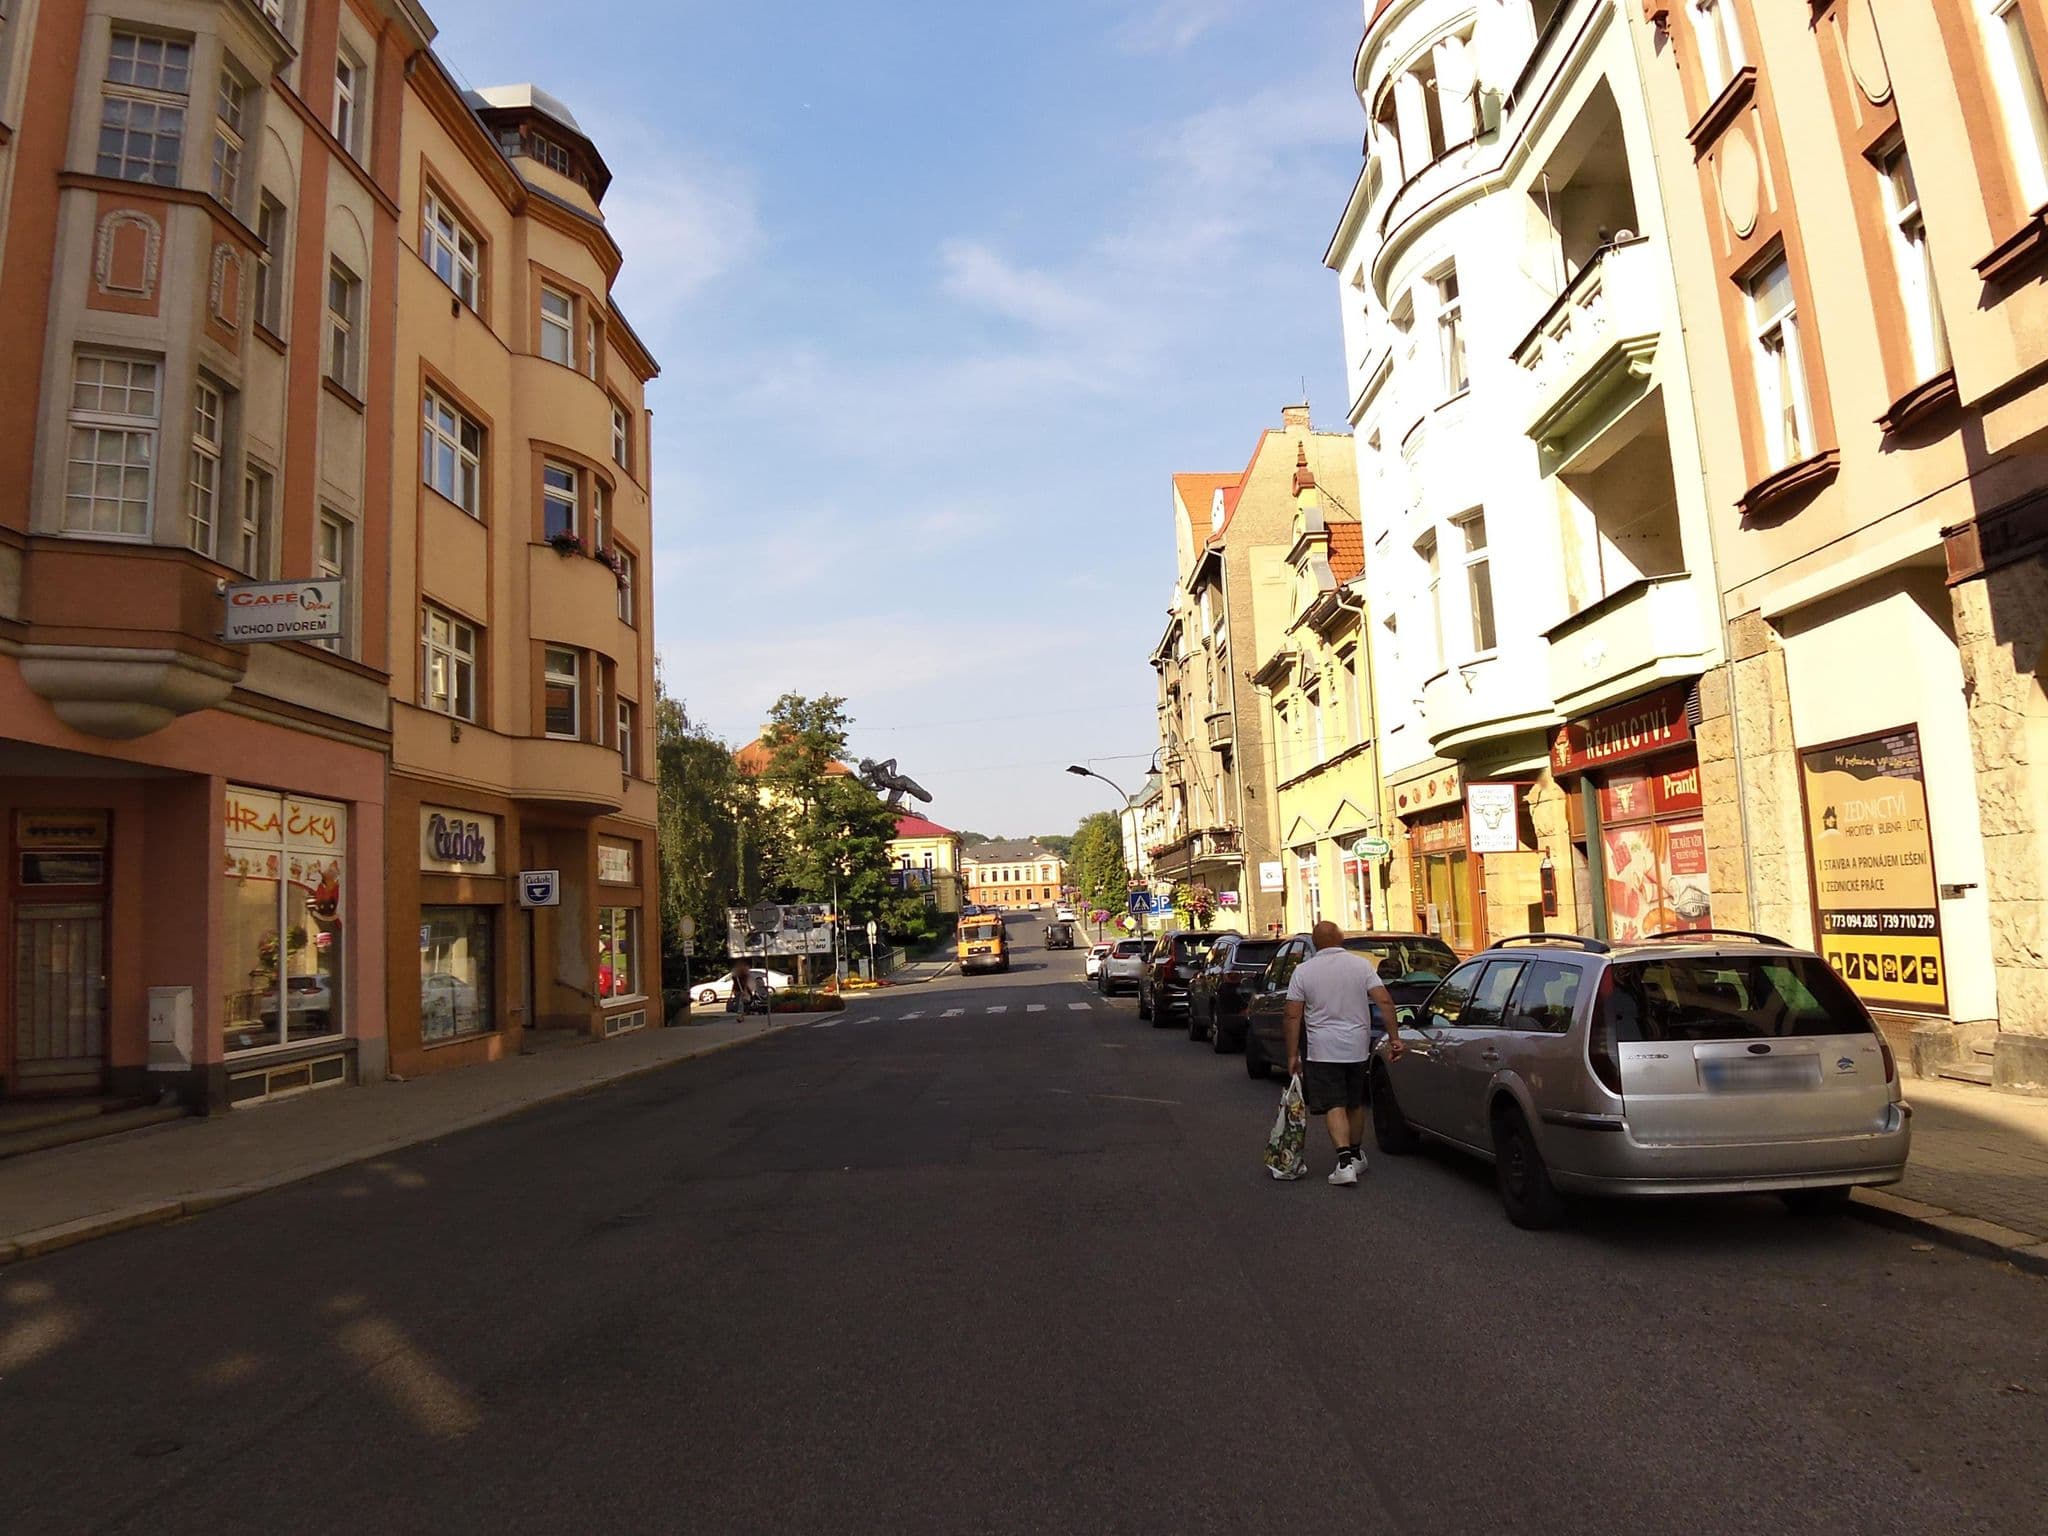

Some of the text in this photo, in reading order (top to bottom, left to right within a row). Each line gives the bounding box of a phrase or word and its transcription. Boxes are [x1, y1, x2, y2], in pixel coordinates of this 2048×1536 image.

[233, 620, 327, 635] VCHOD DVOREM
[224, 801, 336, 844] HRAČKY
[1824, 850, 1927, 870] STAVBA A PRONÁJEM LEŠENÍ
[1826, 876, 1885, 892] ZEDNICKÉ PRÁCE
[1161, 896, 1170, 908] P
[1831, 914, 1935, 929] 773 094 285 739 710 279
